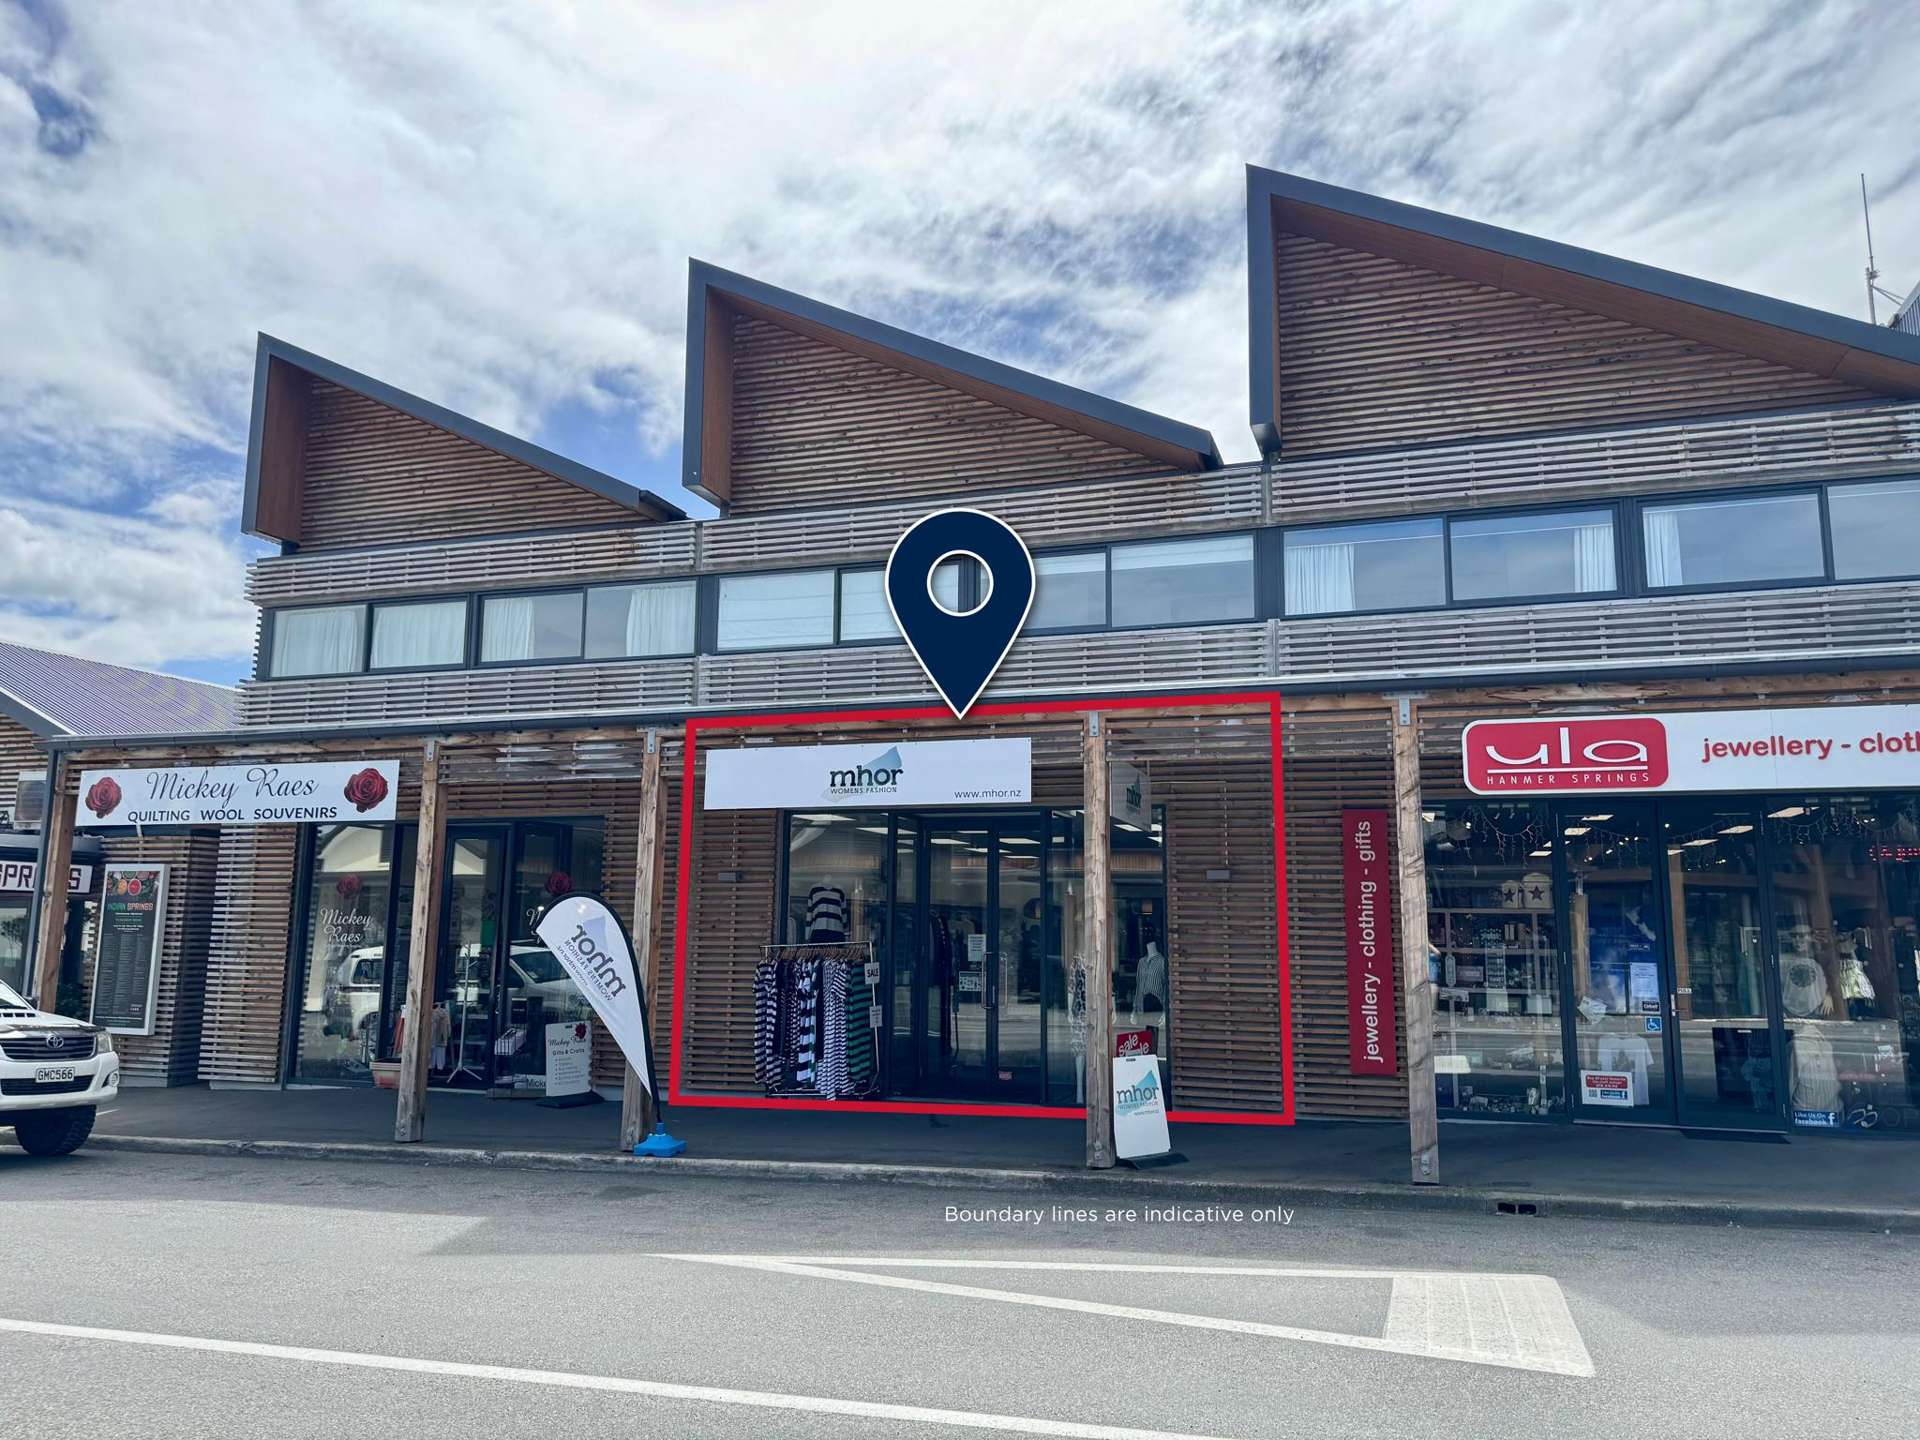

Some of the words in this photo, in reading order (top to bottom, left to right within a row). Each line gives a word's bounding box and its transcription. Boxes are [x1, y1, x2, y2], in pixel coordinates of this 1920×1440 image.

[1486, 727, 1648, 765] ula
[1701, 735, 1833, 764] jewellery
[829, 765, 904, 788] mhor
[1486, 774, 1556, 786] HANMER
[1571, 772, 1649, 784] SPRINGS
[146, 769, 240, 809] Mickey
[246, 767, 320, 798] Raes
[830, 787, 864, 795] WOMENS
[865, 786, 898, 794] FASHION
[954, 789, 1022, 799] www.mhor.nz
[127, 810, 191, 824] QUILTING
[200, 809, 245, 821] WOOL
[253, 807, 338, 820] SOUVENIRS
[1355, 820, 1376, 862] gifts
[320, 907, 371, 931] Mickey
[1357, 881, 1377, 957] clothing
[323, 924, 361, 943] Raes
[866, 968, 879, 978] SALE
[1361, 973, 1384, 1063] jewellery
[37, 1069, 73, 1081] GMC566
[1116, 1084, 1159, 1104] mhor
